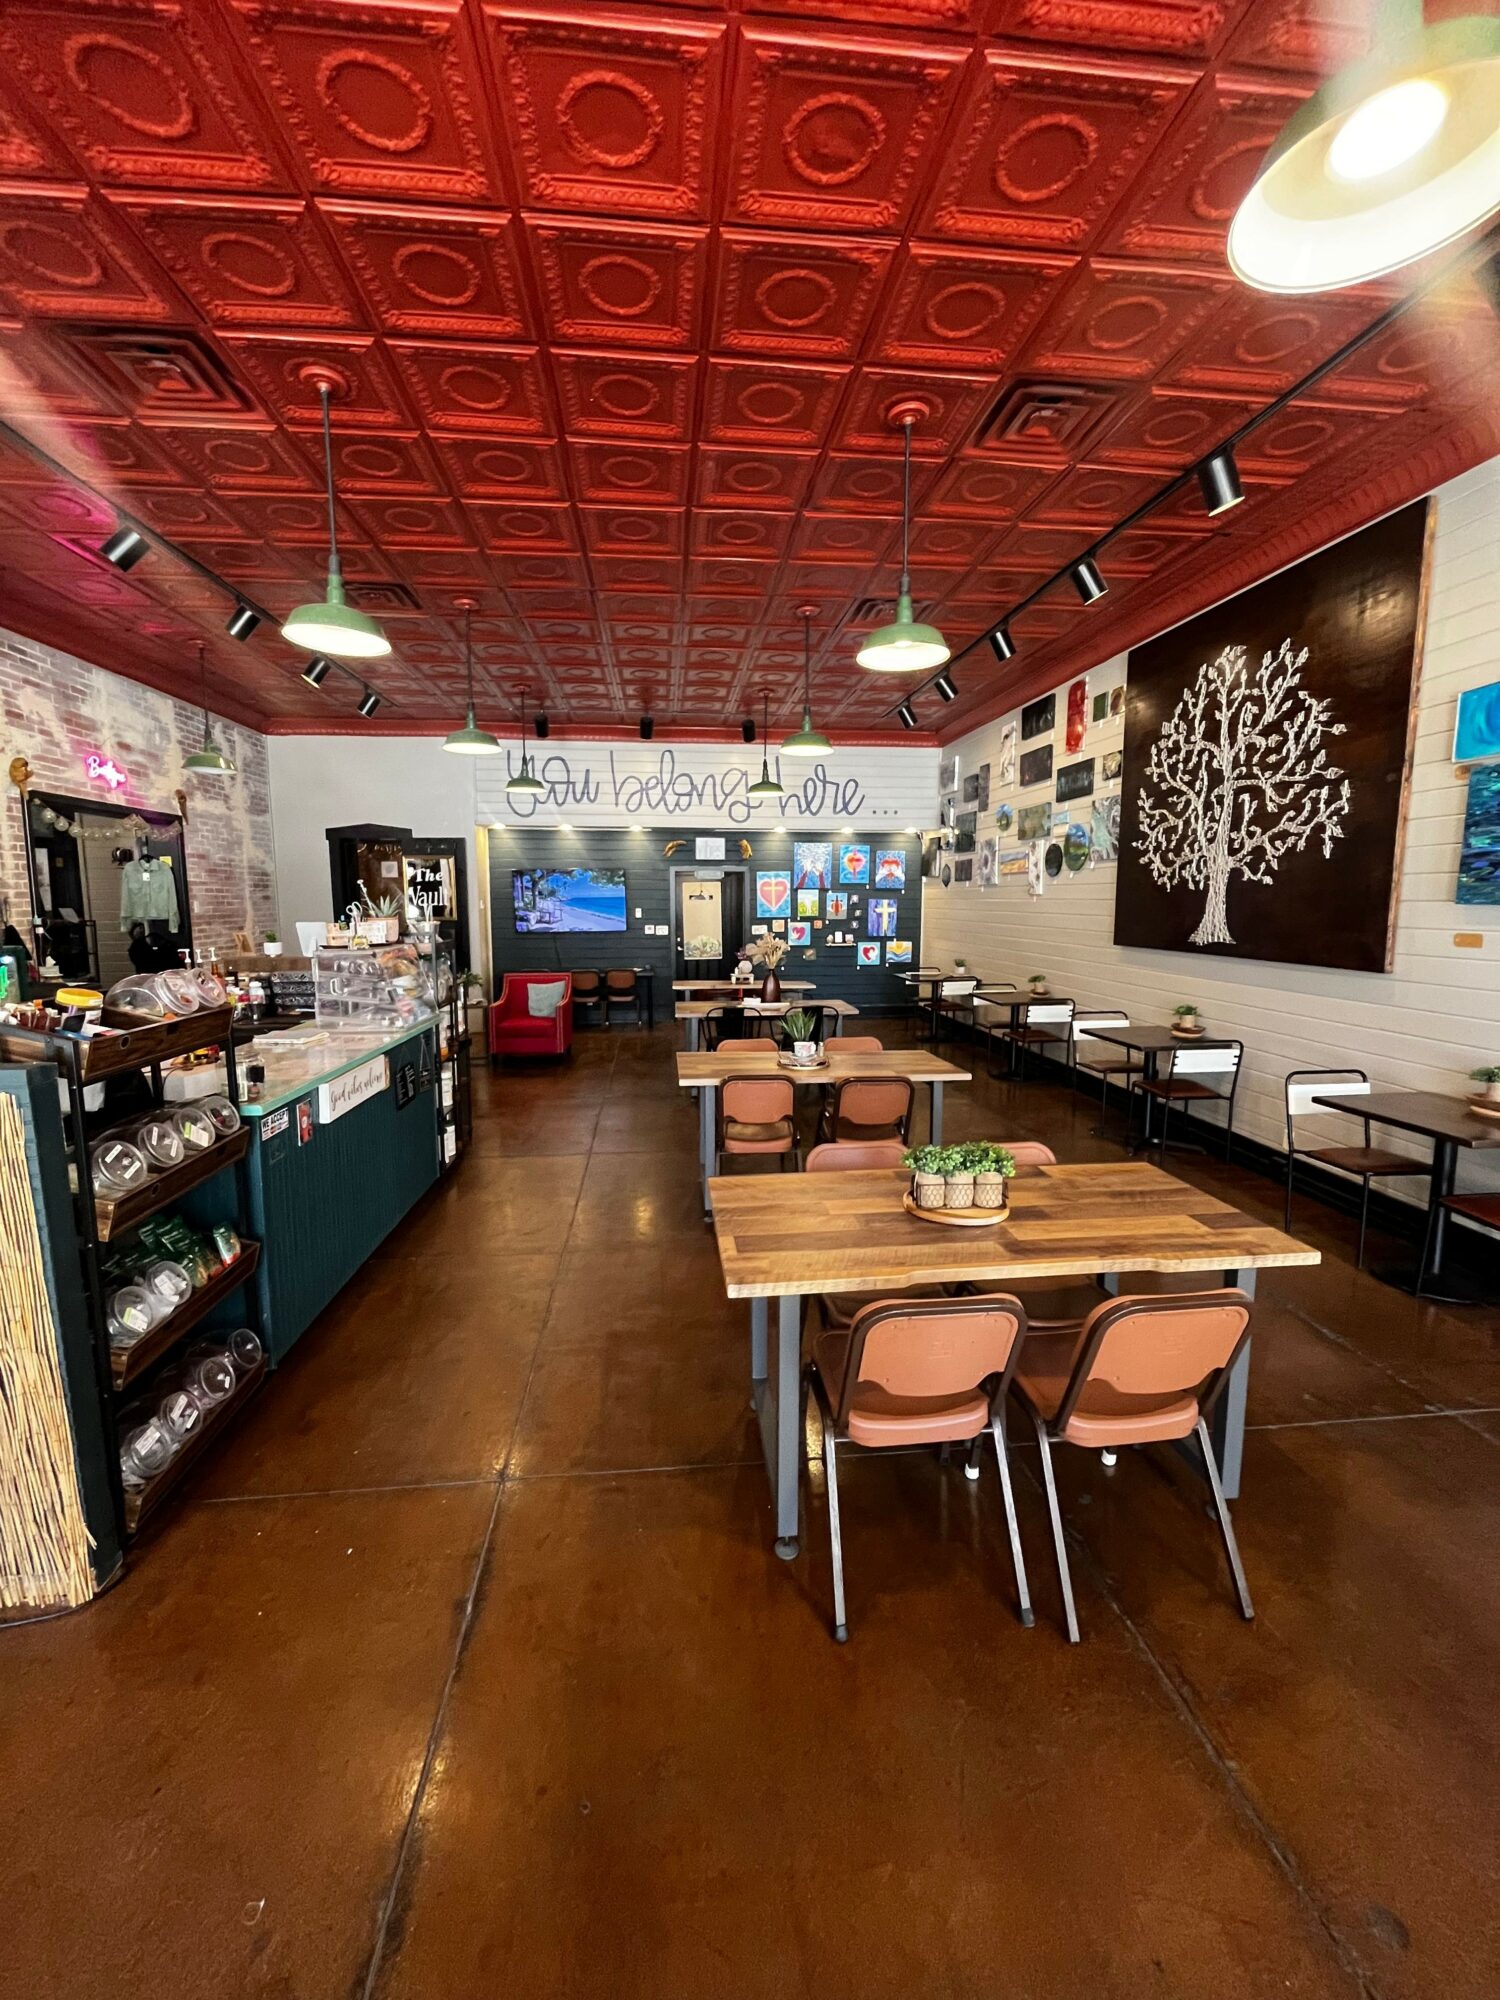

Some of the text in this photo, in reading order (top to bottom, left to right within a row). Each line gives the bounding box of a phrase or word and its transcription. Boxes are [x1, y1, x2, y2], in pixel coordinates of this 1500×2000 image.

[609, 749, 763, 823] belong
[415, 868, 444, 882] The
[262, 1109, 288, 1131] WE ACCEPT
